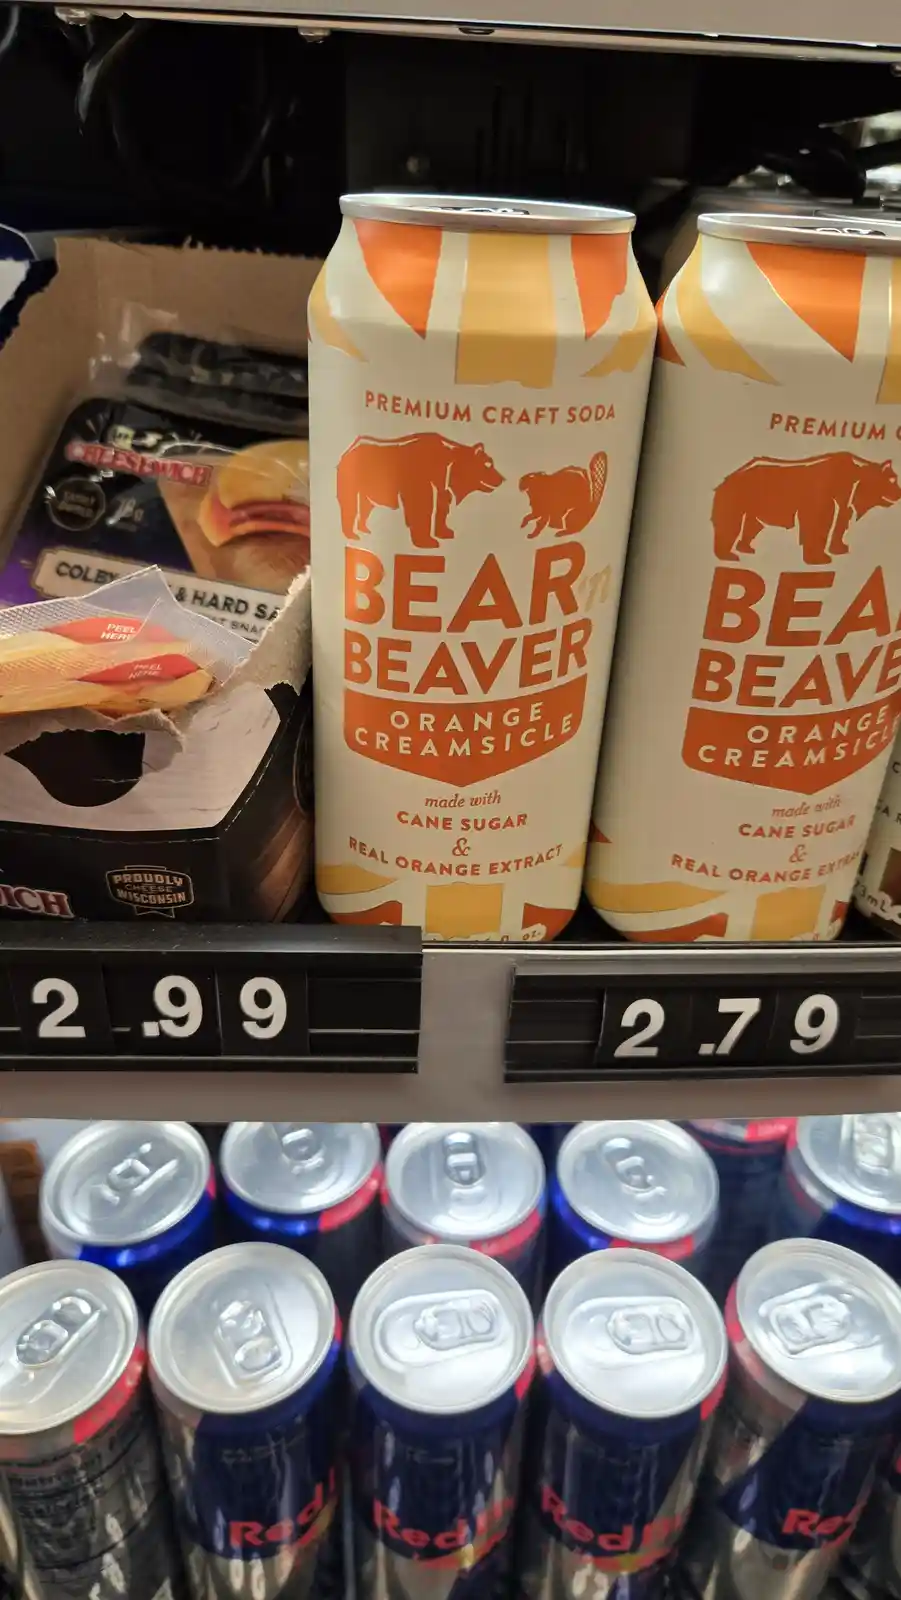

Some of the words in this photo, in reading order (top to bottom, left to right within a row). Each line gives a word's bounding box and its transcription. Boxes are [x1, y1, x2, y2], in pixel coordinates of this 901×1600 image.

[365, 390, 471, 422] PREMIUM
[483, 405, 558, 424] CRAFT
[566, 404, 615, 423] SODA
[770, 413, 886, 440] PREMIUM
[344, 541, 586, 633] BEAR
[192, 590, 249, 615] HARD
[703, 565, 901, 646] BEA
[107, 623, 136, 633] PEEL
[344, 617, 593, 695] BEAVER
[692, 638, 901, 708] BEAVE
[390, 702, 543, 732] ORANGE
[747, 704, 889, 743] ORANGE
[355, 713, 573, 757] CREAMSICLE
[424, 794, 465, 809] made
[470, 790, 502, 807] with
[772, 802, 810, 818] made
[814, 795, 841, 812] with
[396, 811, 453, 830] CANE
[460, 814, 528, 831] SUGAR
[738, 823, 796, 838] CANE
[802, 815, 856, 838] SUGAR
[349, 837, 389, 864] REAL
[395, 855, 481, 876] ORANGE
[488, 844, 563, 875] EXTRACT
[452, 837, 471, 856] &
[788, 844, 807, 863] &
[111, 873, 184, 887] PROUDLY
[671, 854, 720, 878] REAL
[728, 867, 813, 884] ORANGE
[116, 888, 186, 905] WISCONSIN
[124, 884, 173, 893] CHEESE
